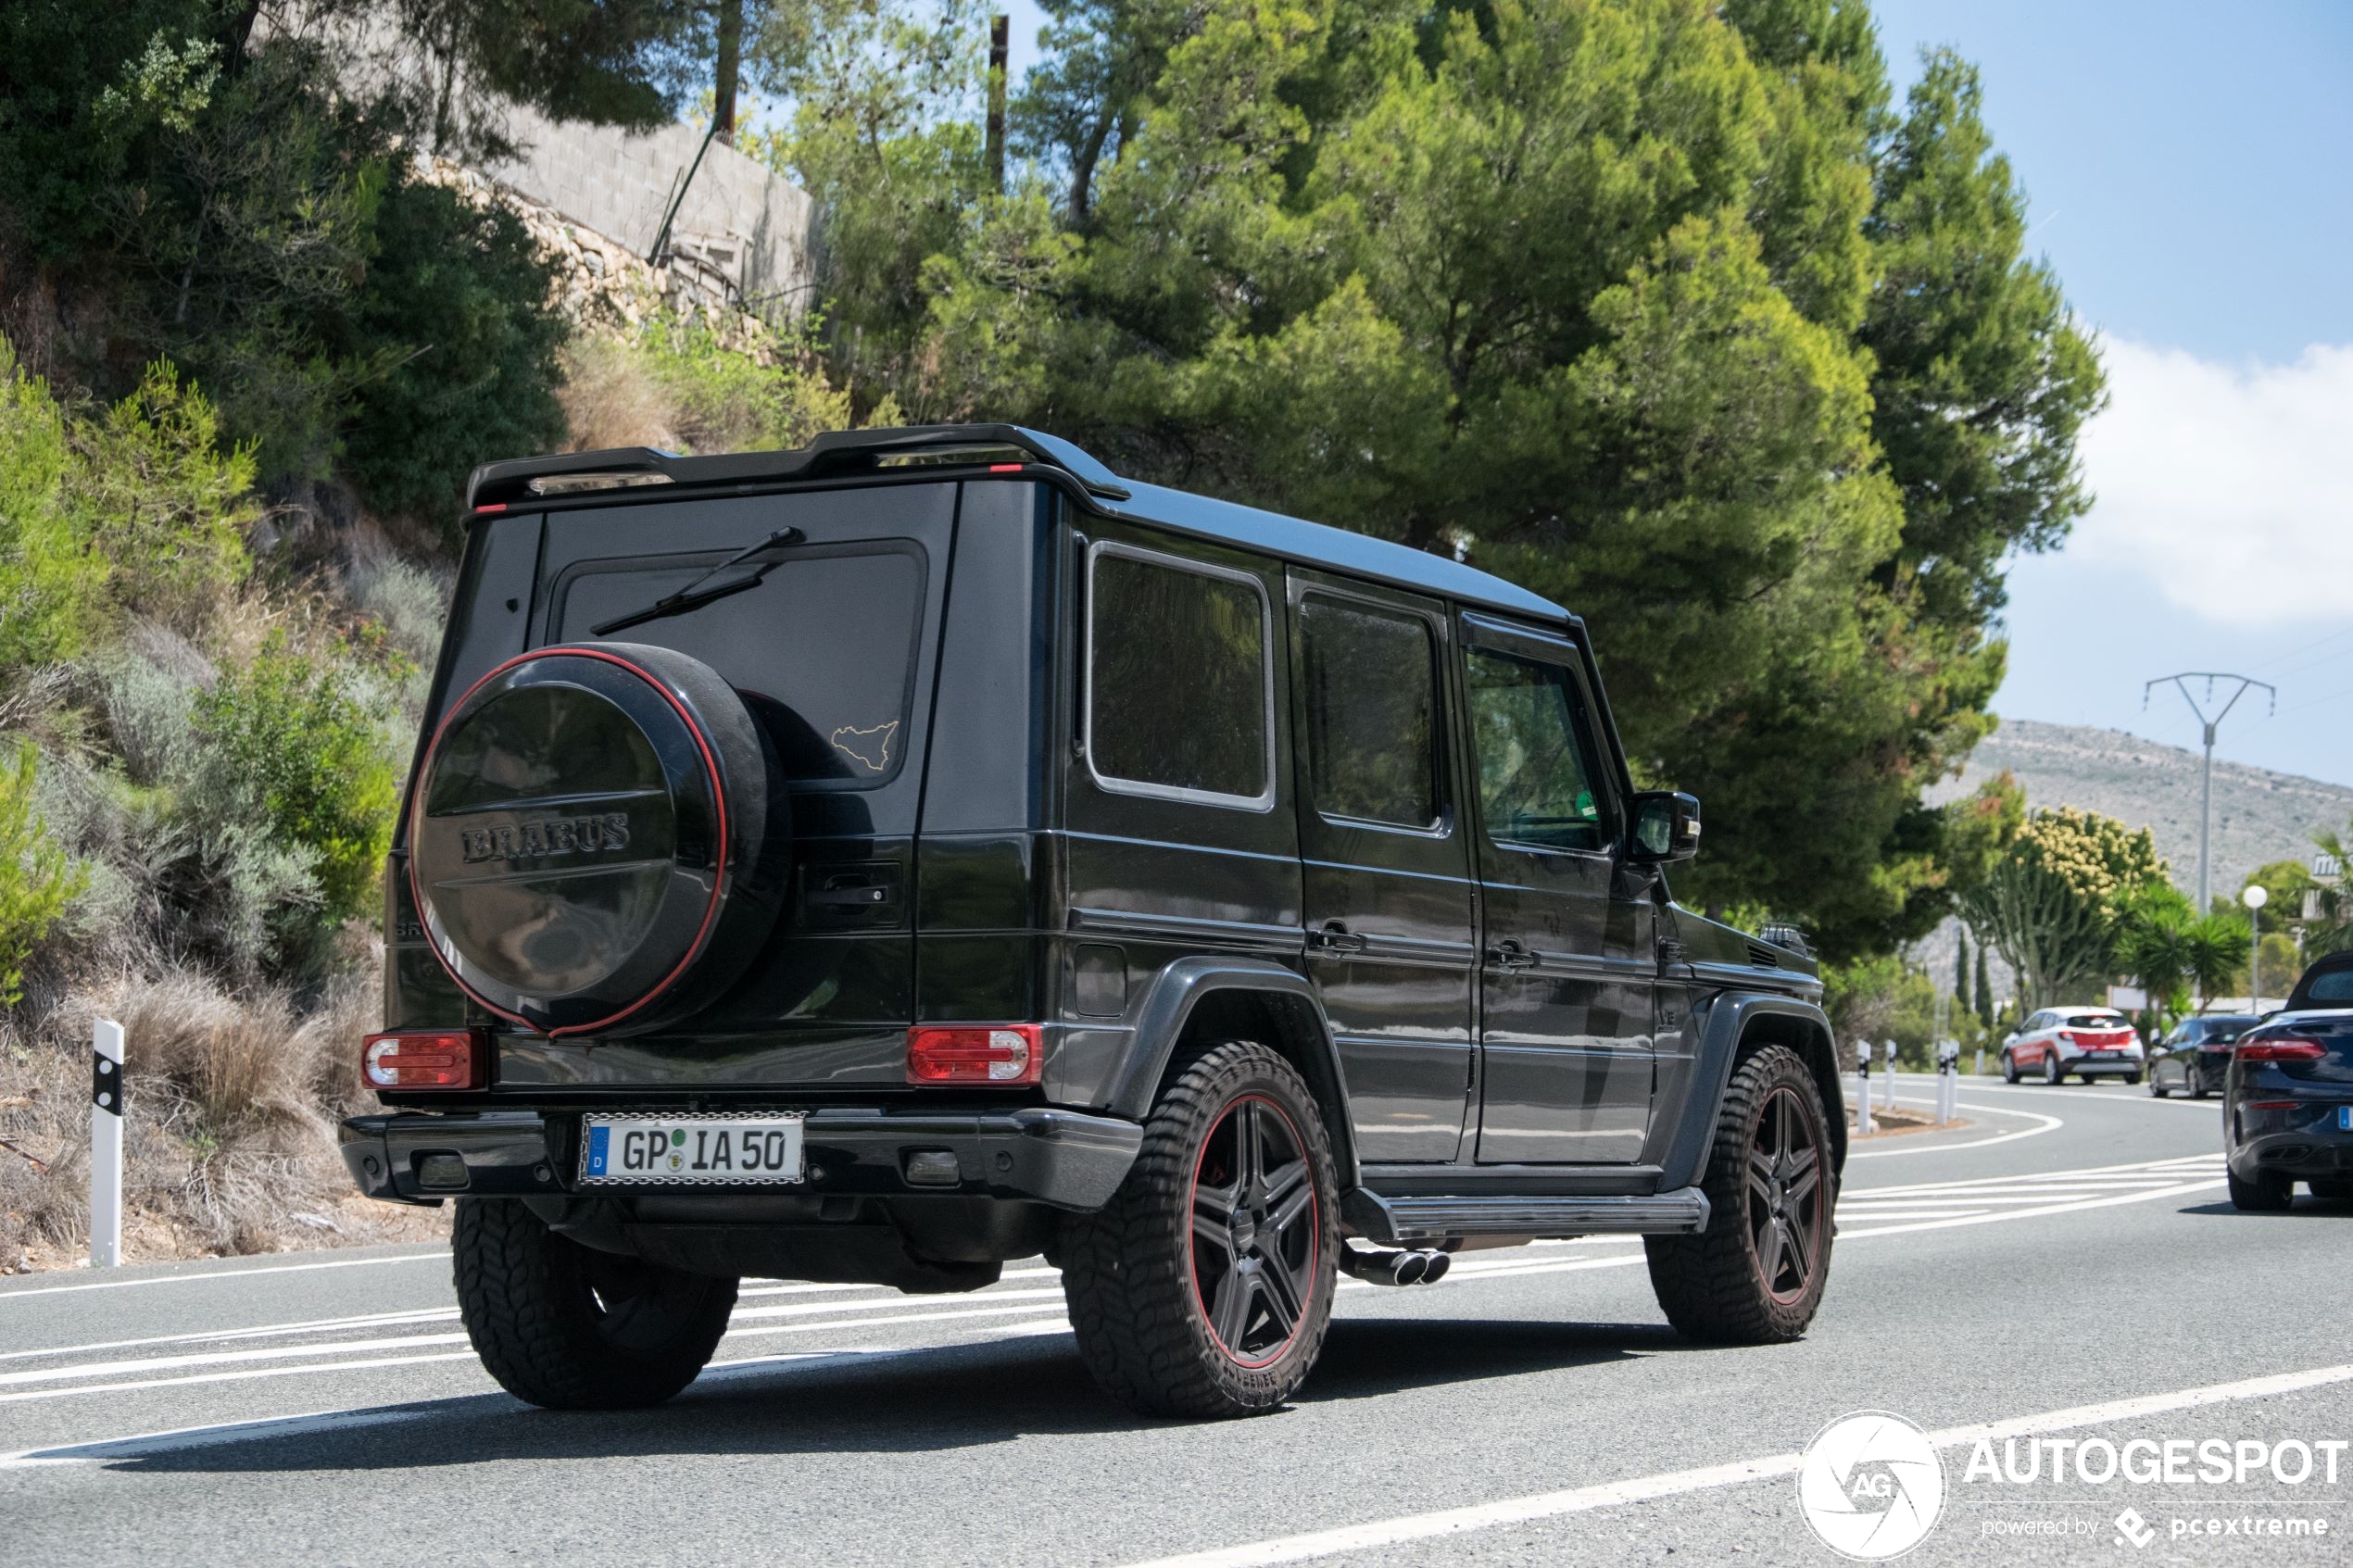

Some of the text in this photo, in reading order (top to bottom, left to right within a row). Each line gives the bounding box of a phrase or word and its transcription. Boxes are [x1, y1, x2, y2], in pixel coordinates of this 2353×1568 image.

[462, 812, 631, 863] BRABUS
[594, 1156, 602, 1168] D
[623, 1131, 668, 1170] GP
